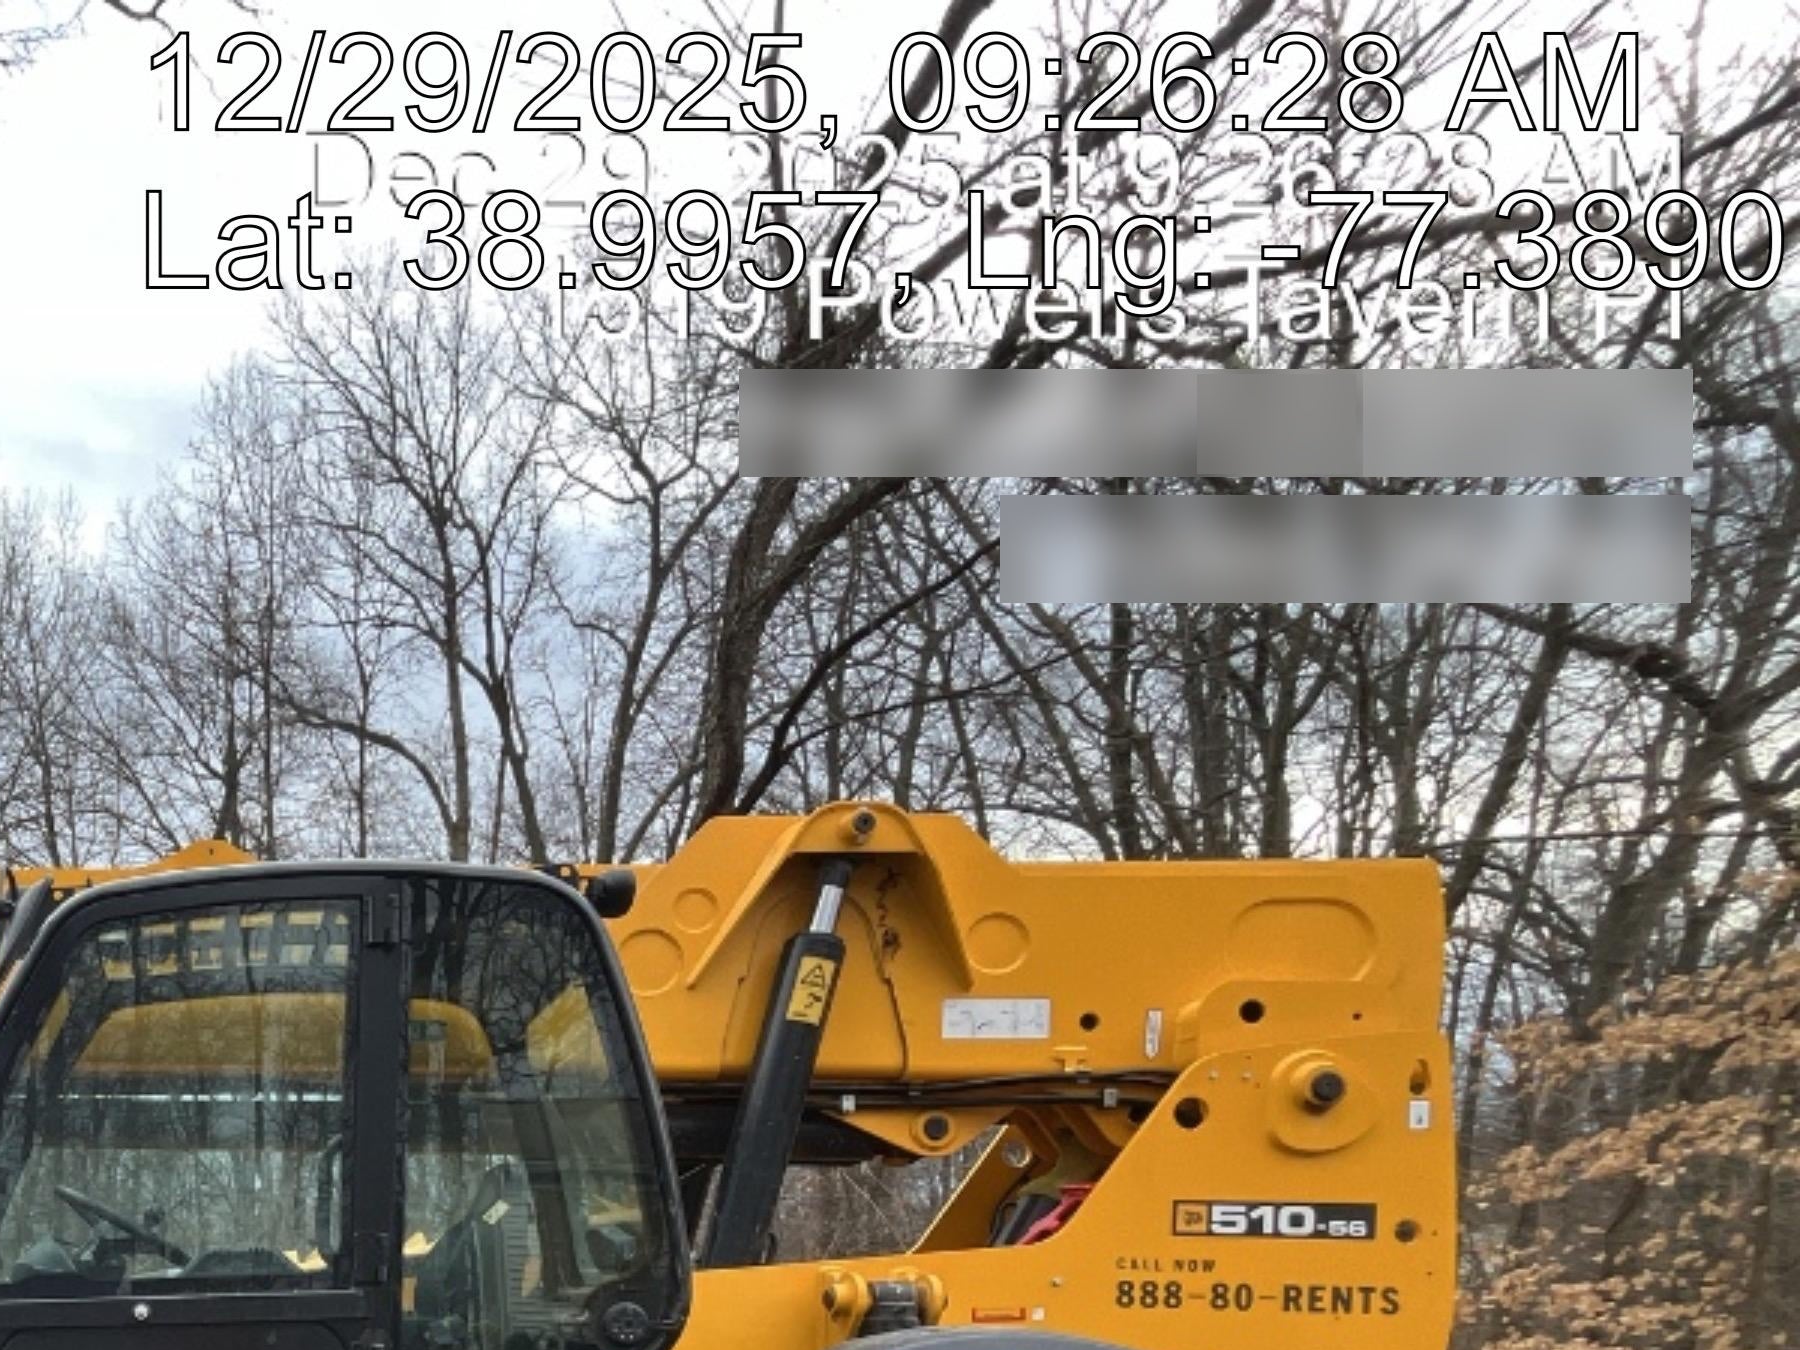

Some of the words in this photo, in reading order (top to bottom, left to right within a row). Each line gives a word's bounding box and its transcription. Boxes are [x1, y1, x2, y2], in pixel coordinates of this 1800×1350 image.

[1115, 1256, 1162, 1272] CALL
[1173, 1258, 1217, 1273] NOW
[1115, 1279, 1401, 1315] 888-80-RENTS
